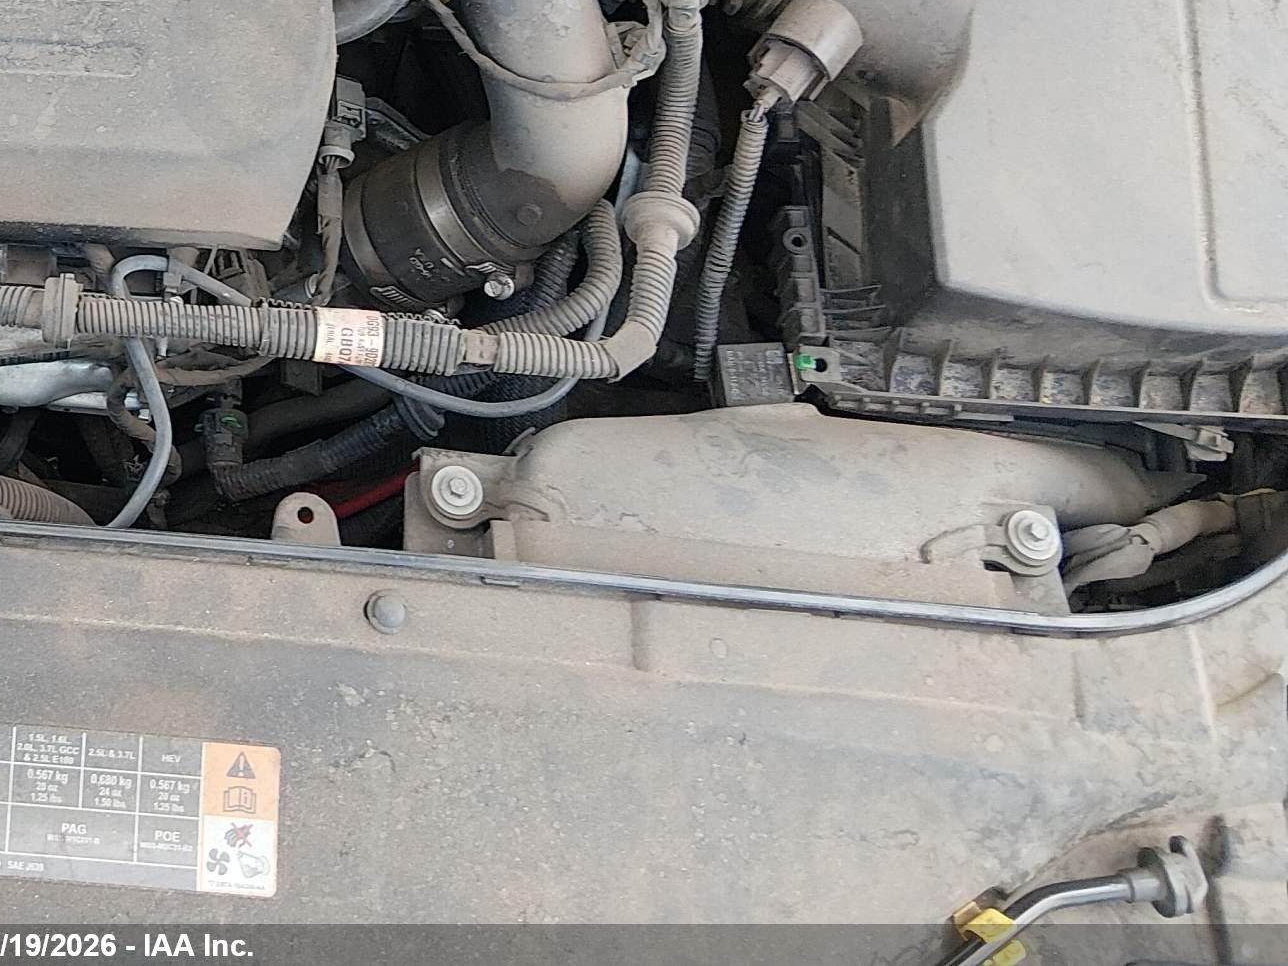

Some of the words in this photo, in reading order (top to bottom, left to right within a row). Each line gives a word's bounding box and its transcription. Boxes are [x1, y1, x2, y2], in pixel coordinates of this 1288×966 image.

[59, 745, 81, 755] GCC
[88, 748, 107, 757] 2.5L
[161, 753, 182, 763] HEV
[26, 768, 54, 780] 0.567
[55, 770, 69, 785] kg
[47, 784, 58, 792] oz
[119, 775, 133, 790] kg
[150, 778, 176, 791] 0.567
[177, 780, 191, 794] kg
[61, 822, 87, 835] PAG
[154, 830, 181, 842] POE
[7, 860, 25, 870] SAE
